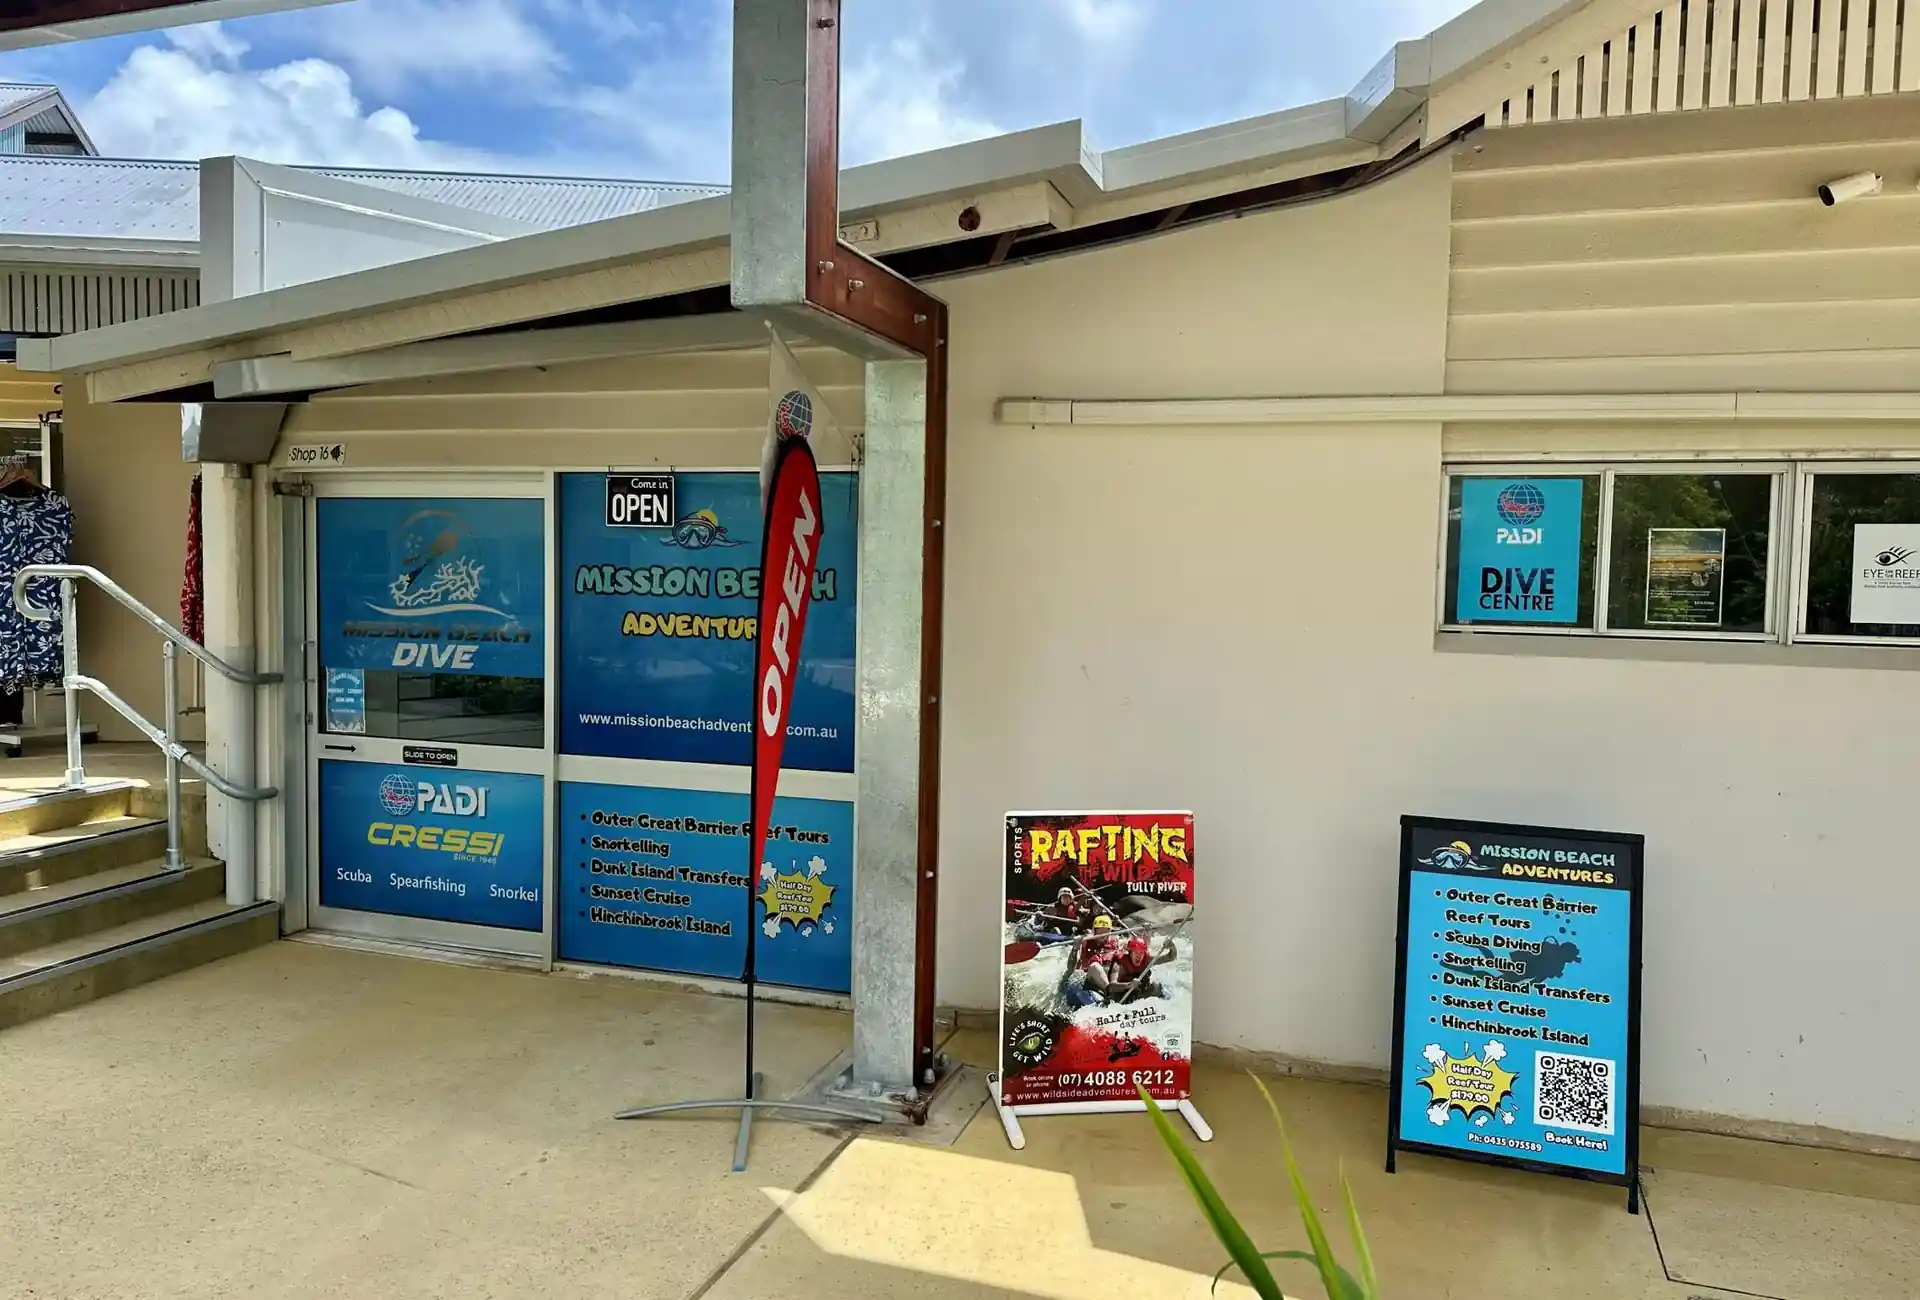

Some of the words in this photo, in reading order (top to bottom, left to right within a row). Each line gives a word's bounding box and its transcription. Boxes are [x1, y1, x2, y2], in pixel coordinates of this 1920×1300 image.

[291, 447, 316, 464] Shop
[320, 446, 329, 460] 16
[631, 478, 657, 489] Come
[658, 480, 669, 489] in
[612, 494, 668, 523] OPEN
[1497, 527, 1543, 544] PADI
[575, 565, 709, 598] MISSION
[715, 567, 836, 601] BEH
[1481, 567, 1555, 594] DIVE
[1863, 568, 1885, 578] EYE
[762, 490, 817, 737] OPEN
[1479, 594, 1554, 611] CENTRE
[343, 620, 441, 640] MISSION
[447, 623, 532, 643] BEACH
[622, 611, 757, 641] ADVENTUR
[391, 643, 479, 669] DIVE
[579, 712, 837, 739] www.missionbeachadventcom.au
[404, 751, 424, 759] SLIDE
[418, 781, 487, 817] PADI
[591, 810, 634, 828] Outer
[638, 814, 681, 831] Great
[685, 819, 739, 836] Barrier
[741, 822, 782, 840] Ref
[785, 826, 829, 844] Tours
[367, 822, 505, 856] CRESSI
[591, 836, 670, 857] Snorkelling
[1029, 822, 1189, 870] RAFTING
[453, 853, 477, 862] SINCE
[1014, 827, 1023, 874] SPORTS
[1480, 844, 1550, 861] MISSION
[1554, 850, 1616, 867] BEACH
[591, 859, 627, 875] Dunk
[630, 862, 674, 880] Island
[678, 867, 751, 887] Transfers
[1501, 862, 1615, 884] ADVENTURES
[337, 868, 372, 883] Scuba
[390, 873, 466, 897] Spearfishing
[490, 884, 538, 902] Snorkel
[591, 884, 639, 901] Sunset
[643, 889, 691, 906] Cruise
[776, 891, 795, 901] Reef
[780, 880, 796, 890] Half
[797, 882, 813, 893] Day
[1126, 881, 1155, 893] TULLY
[1157, 881, 1188, 895] RIVER
[780, 904, 809, 913] $179.00
[1446, 888, 1491, 904] Outer
[1493, 893, 1538, 909] Great
[1542, 896, 1598, 915] Barrier
[590, 908, 682, 930] Hinchinbrook
[686, 917, 731, 936] Island
[1445, 909, 1484, 924] Reef
[1487, 914, 1531, 930] Tours
[1445, 931, 1489, 946] Scuba
[1492, 934, 1542, 954] Diving
[1443, 952, 1526, 974] Snorkelling
[1443, 972, 1480, 988] Dunk
[1484, 976, 1530, 994] Island
[1533, 983, 1611, 1004] Transfers
[1096, 1013, 1121, 1026] Half
[1132, 1006, 1157, 1018] Full
[1442, 994, 1494, 1012] Sunset
[1497, 1000, 1547, 1018] Cruise
[1119, 1020, 1136, 1028] day
[1139, 1014, 1166, 1024] tours
[1441, 1015, 1537, 1039] Hinchinbrook
[1541, 1026, 1589, 1046] Island
[1008, 1021, 1026, 1046] LIFE'S
[1027, 1020, 1051, 1034] SHORT
[1012, 1051, 1029, 1063] GET
[1032, 1038, 1052, 1062] WILD
[1058, 1073, 1081, 1087] (07)
[1084, 1071, 1126, 1086] 4088
[1132, 1069, 1174, 1084] 6212
[1452, 1064, 1473, 1075] Half
[1473, 1067, 1493, 1079] Day
[1447, 1076, 1471, 1087] Reef
[1472, 1080, 1495, 1091] Tour
[1450, 1090, 1489, 1103] $179.00
[1468, 1132, 1483, 1143] Ph:
[1483, 1135, 1507, 1147] 0435
[1508, 1138, 1542, 1152] 075589
[1545, 1132, 1574, 1146] Book
[1574, 1136, 1608, 1151] Here!
